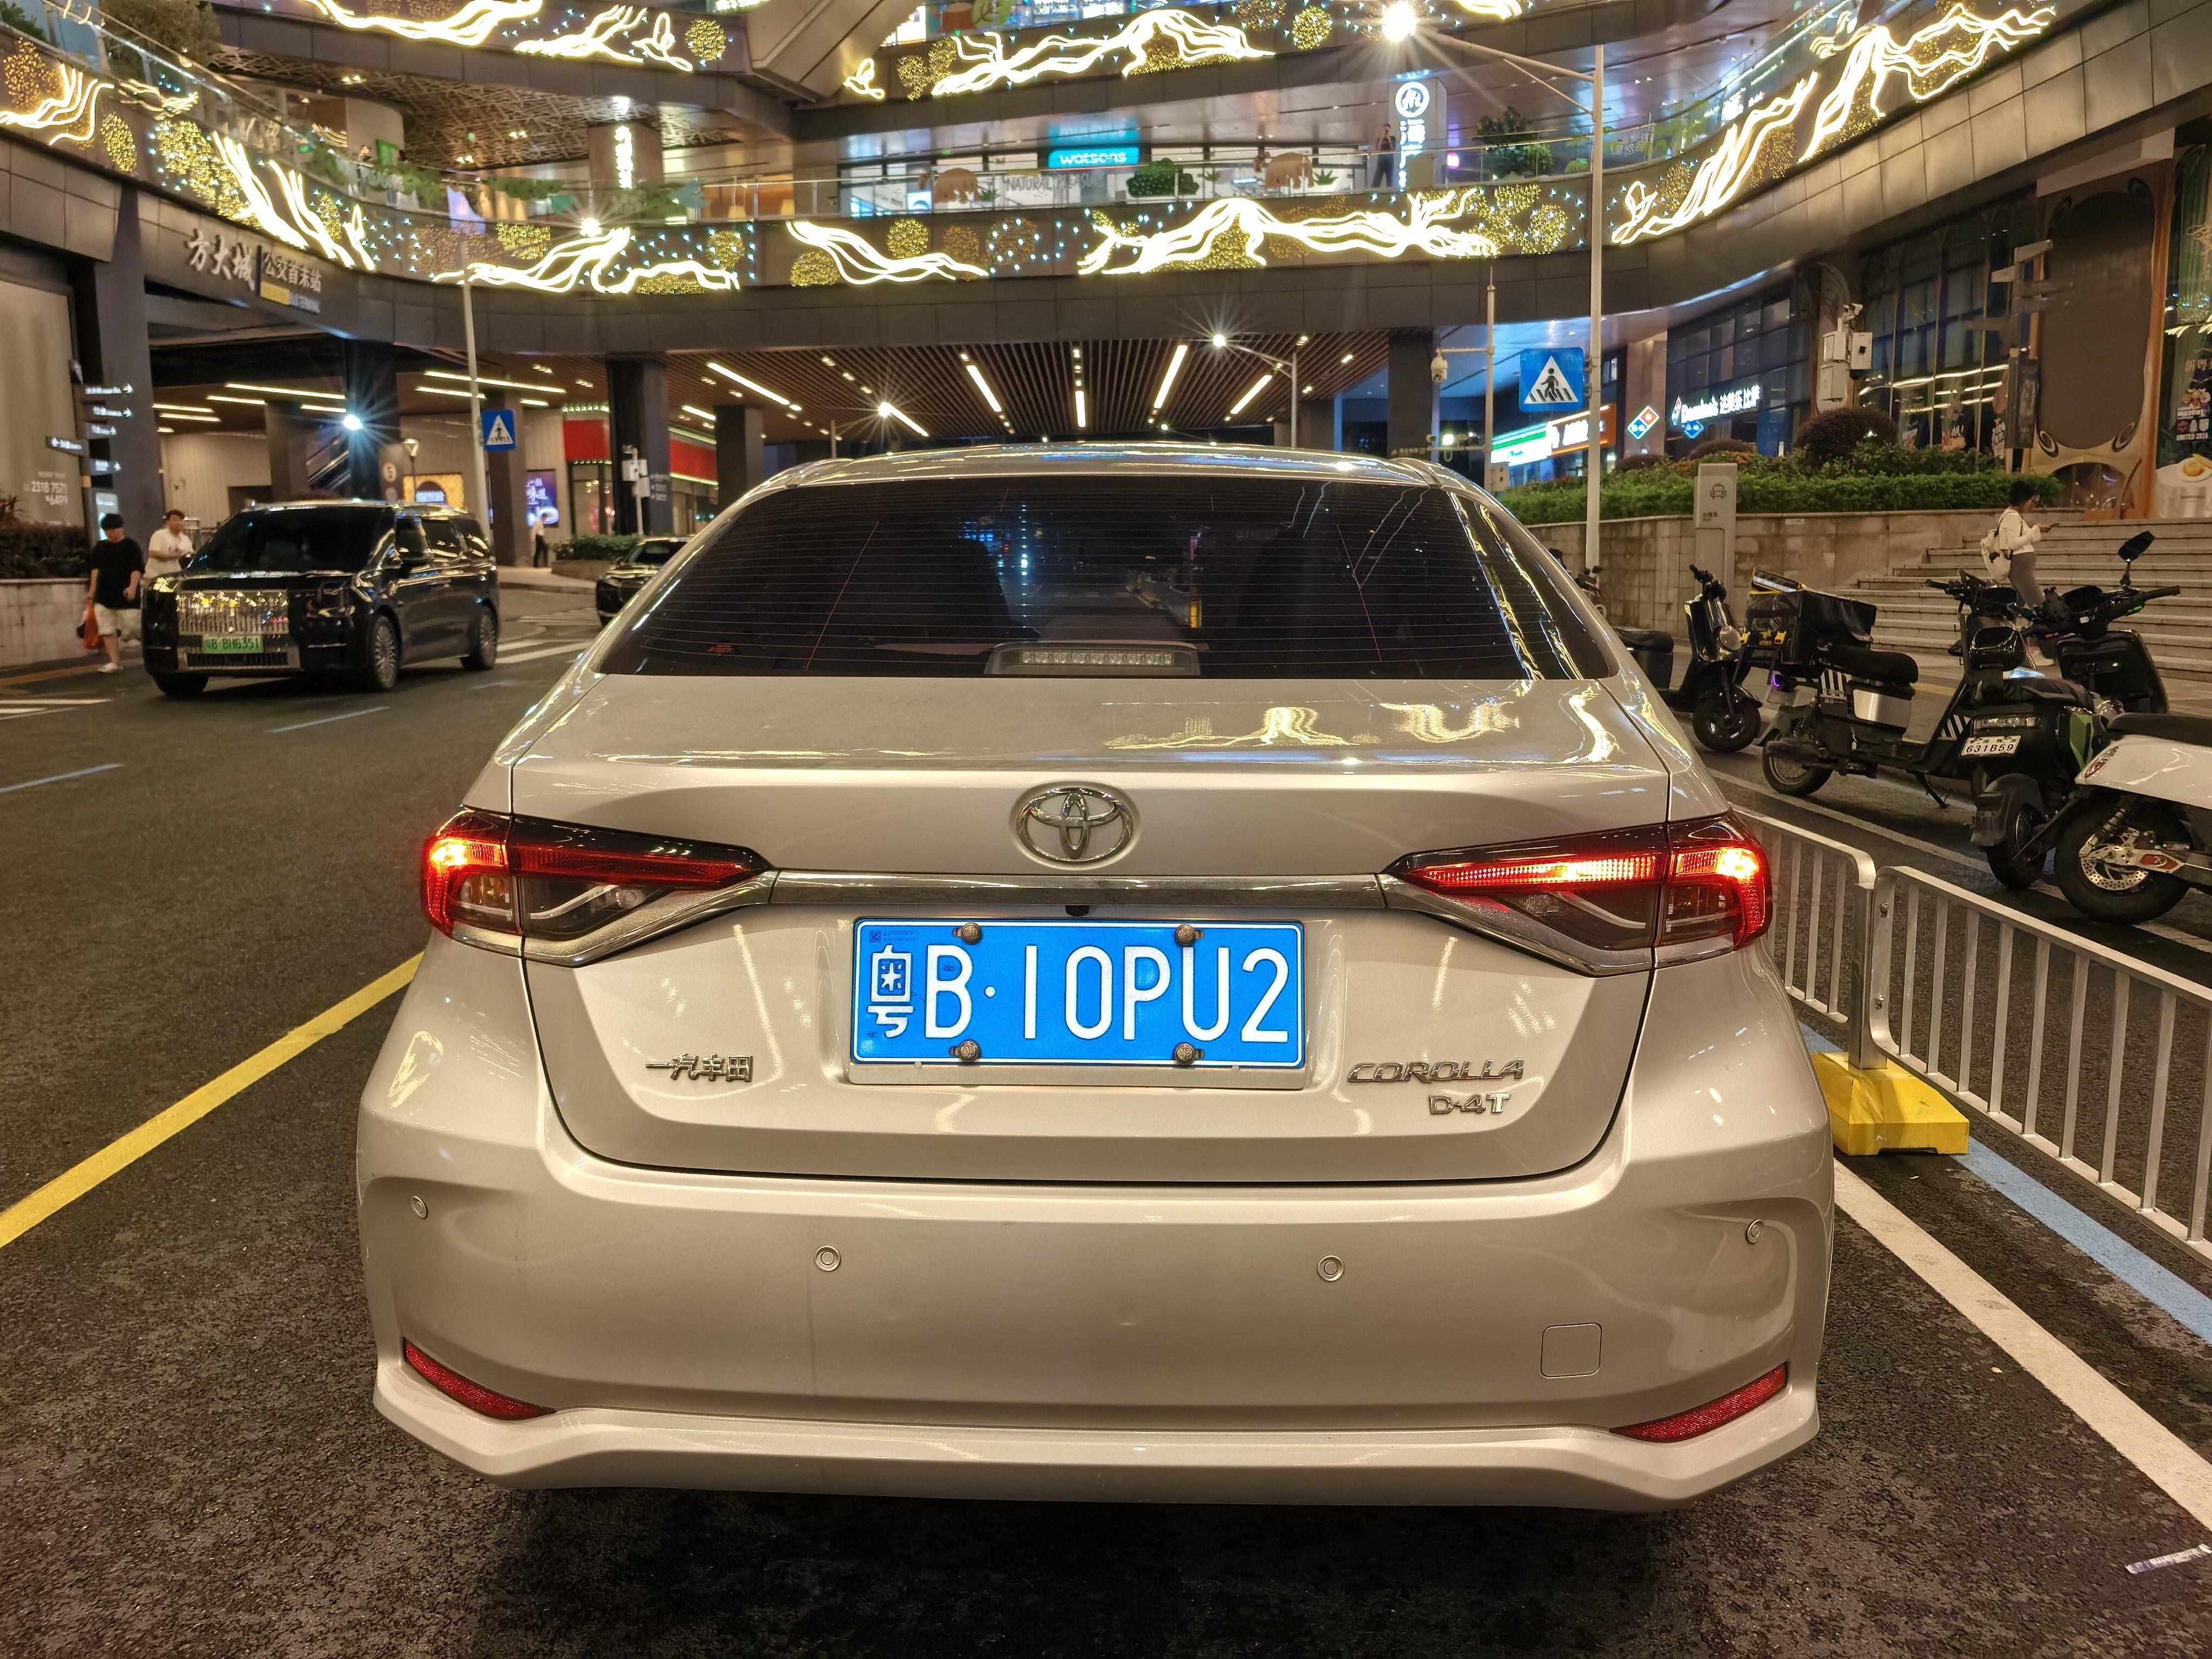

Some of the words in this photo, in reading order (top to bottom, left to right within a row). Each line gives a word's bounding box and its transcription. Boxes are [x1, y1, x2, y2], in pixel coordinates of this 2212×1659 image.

[1058, 152, 1127, 165] watsons
[184, 228, 255, 292] 方大城
[1966, 744, 2014, 753] 631B59
[645, 1053, 753, 1082] 一汽丰田
[1347, 1058, 1525, 1083] COROLLA
